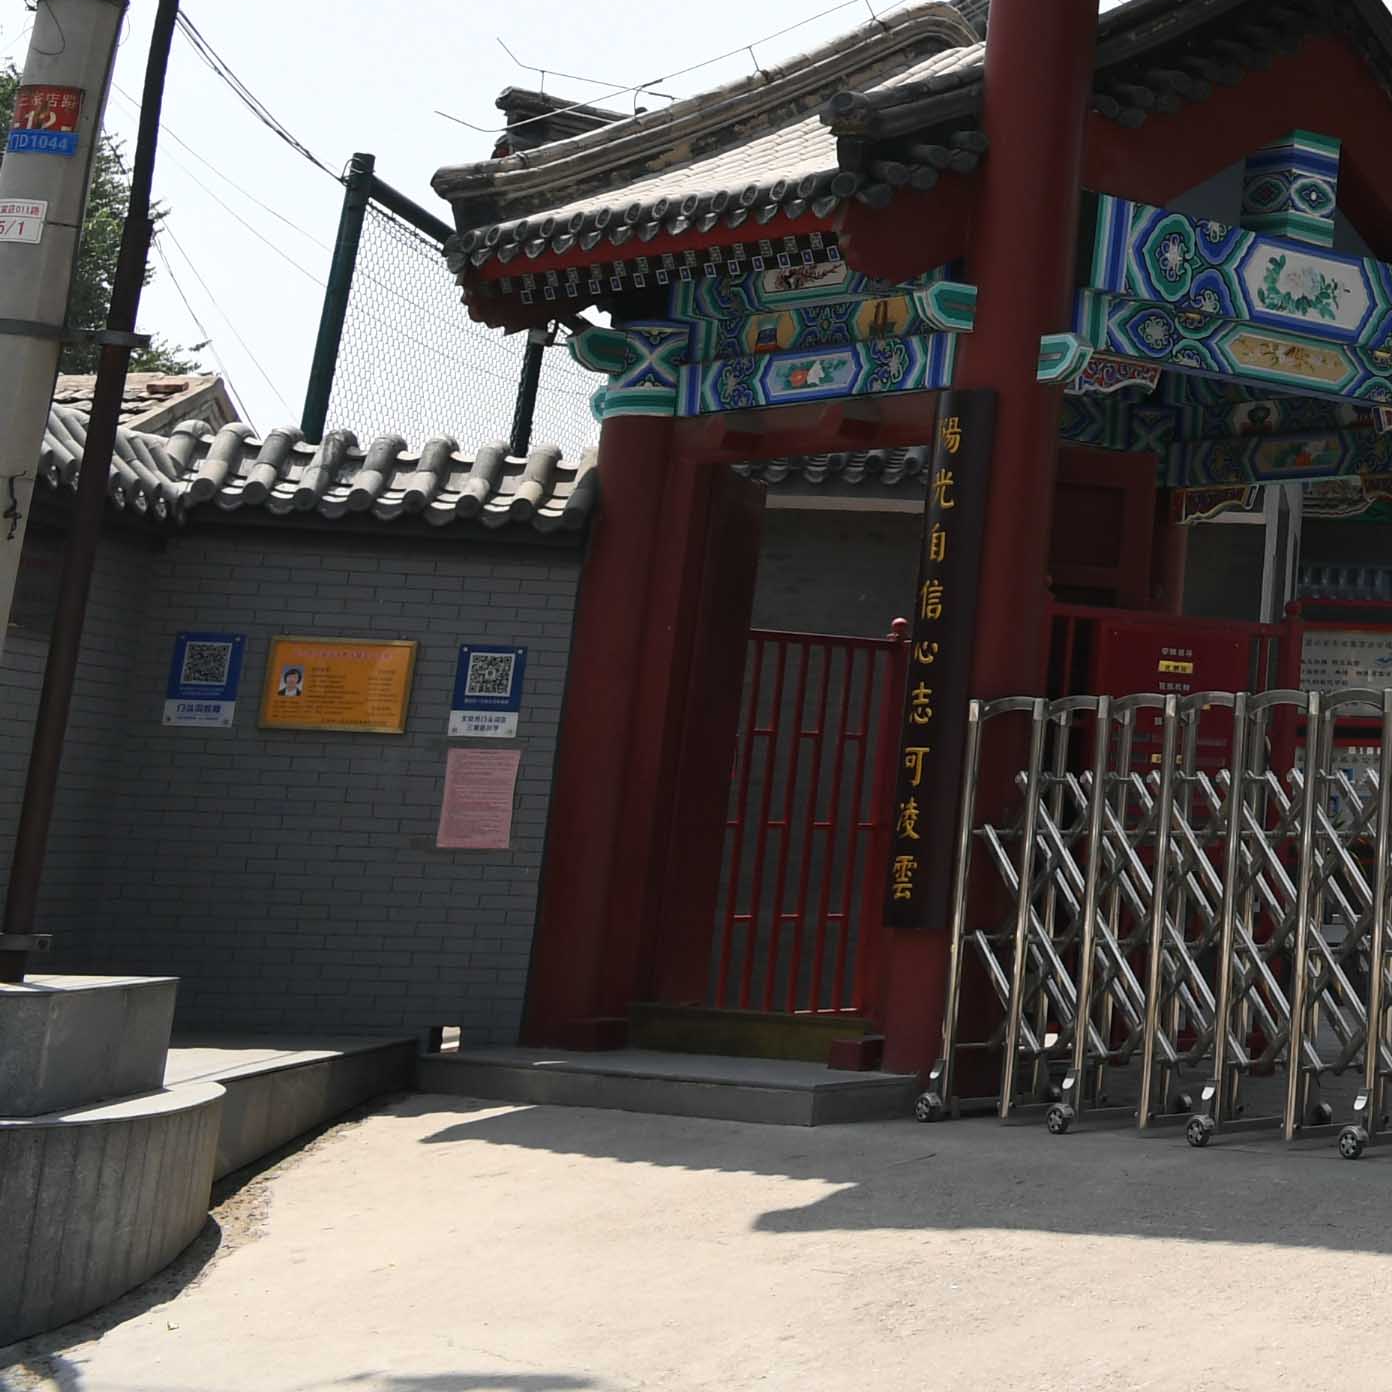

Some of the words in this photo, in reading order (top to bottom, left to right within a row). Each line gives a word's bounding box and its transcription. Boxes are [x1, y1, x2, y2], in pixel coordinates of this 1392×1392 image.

[893, 417, 961, 900] 陽光自信心志可凌雲
